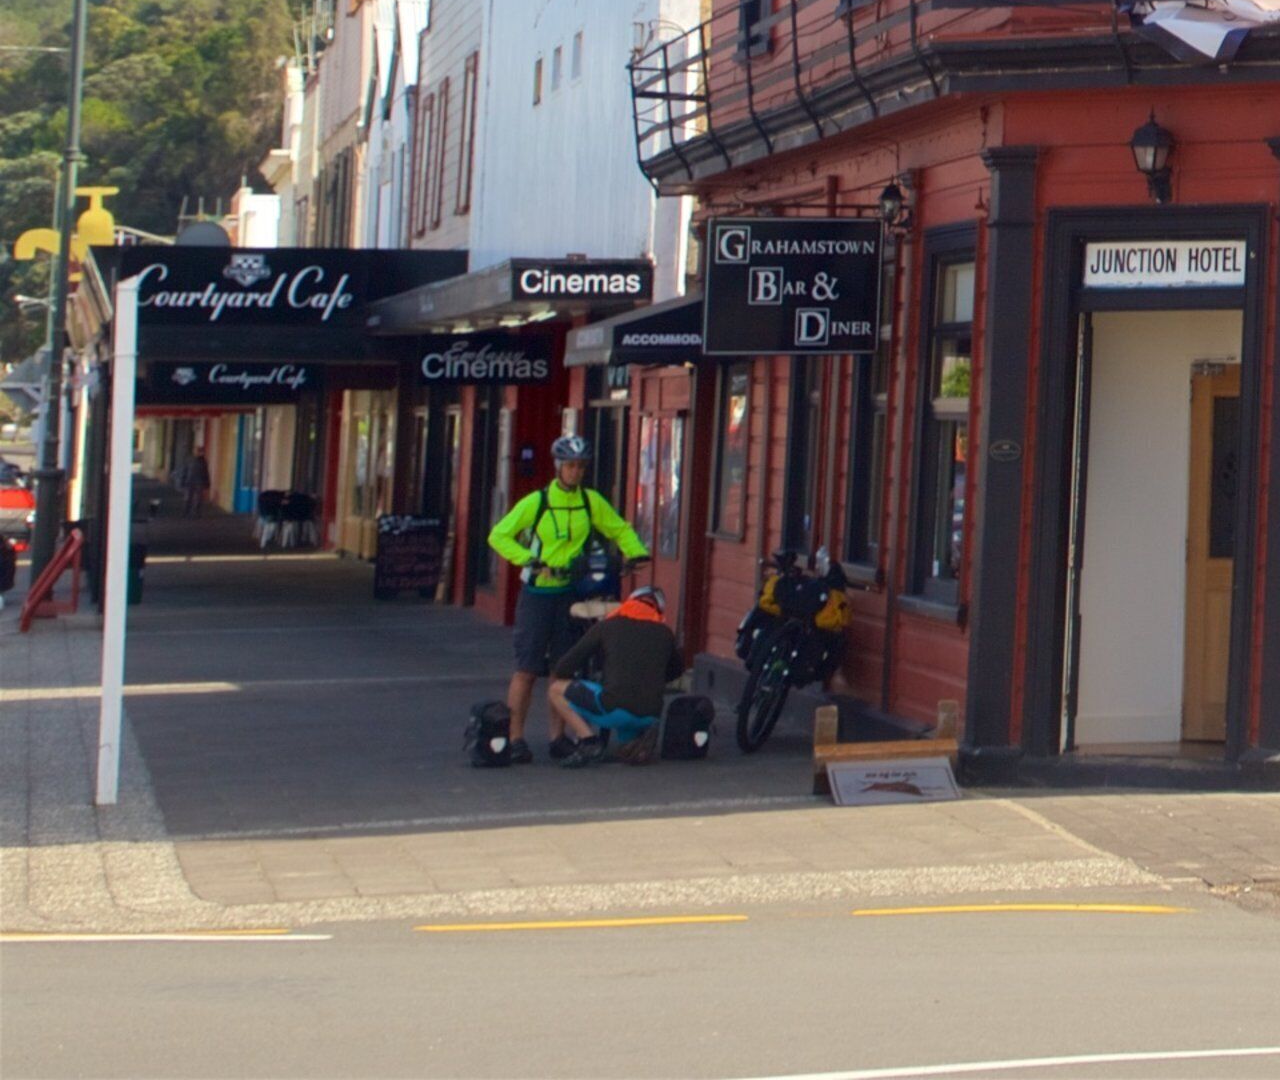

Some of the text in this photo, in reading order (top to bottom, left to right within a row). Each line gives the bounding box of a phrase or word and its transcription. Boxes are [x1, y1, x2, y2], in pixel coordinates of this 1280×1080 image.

[718, 229, 876, 259] GRAHAMSTOWN
[1090, 247, 1242, 274] JUNCTION HOTEL
[136, 263, 354, 321] Courtyard Cafe
[520, 269, 641, 294] Cinemas
[754, 270, 840, 301] BAR &
[798, 313, 873, 342] DINER
[208, 363, 279, 389] Courtyard
[277, 365, 307, 389] Cafe
[421, 352, 548, 380] Cinemas
